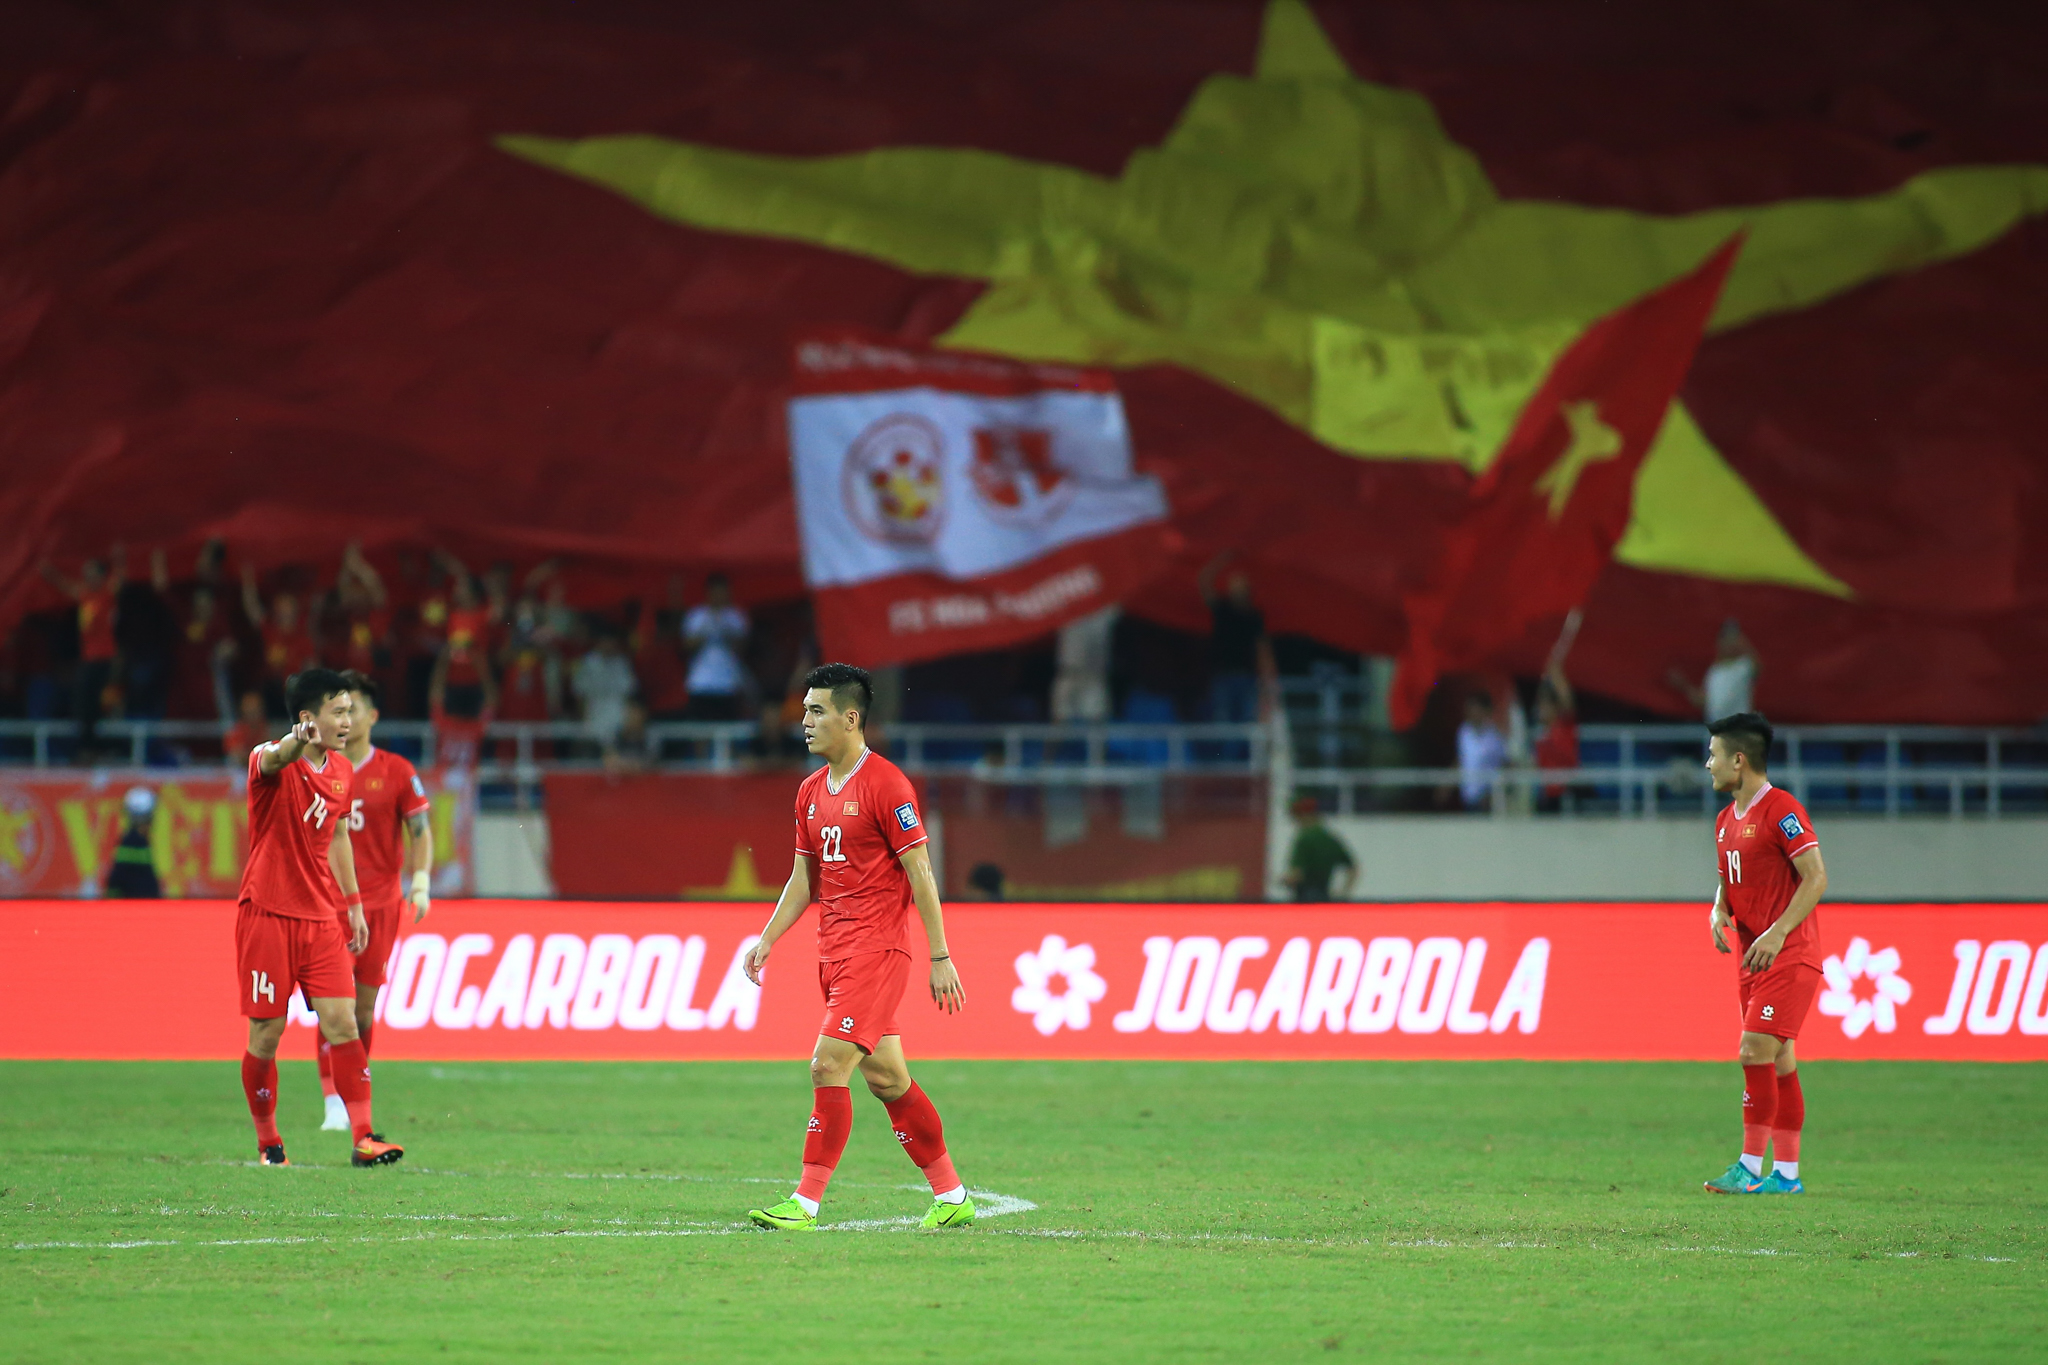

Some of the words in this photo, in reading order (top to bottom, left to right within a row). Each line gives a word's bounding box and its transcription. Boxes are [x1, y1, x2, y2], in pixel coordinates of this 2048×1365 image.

[302, 792, 328, 829] 14
[820, 825, 847, 862] 22
[1725, 850, 1742, 884] 19
[251, 969, 275, 1004] 14
[1112, 935, 1551, 1034] JOGARBOLA
